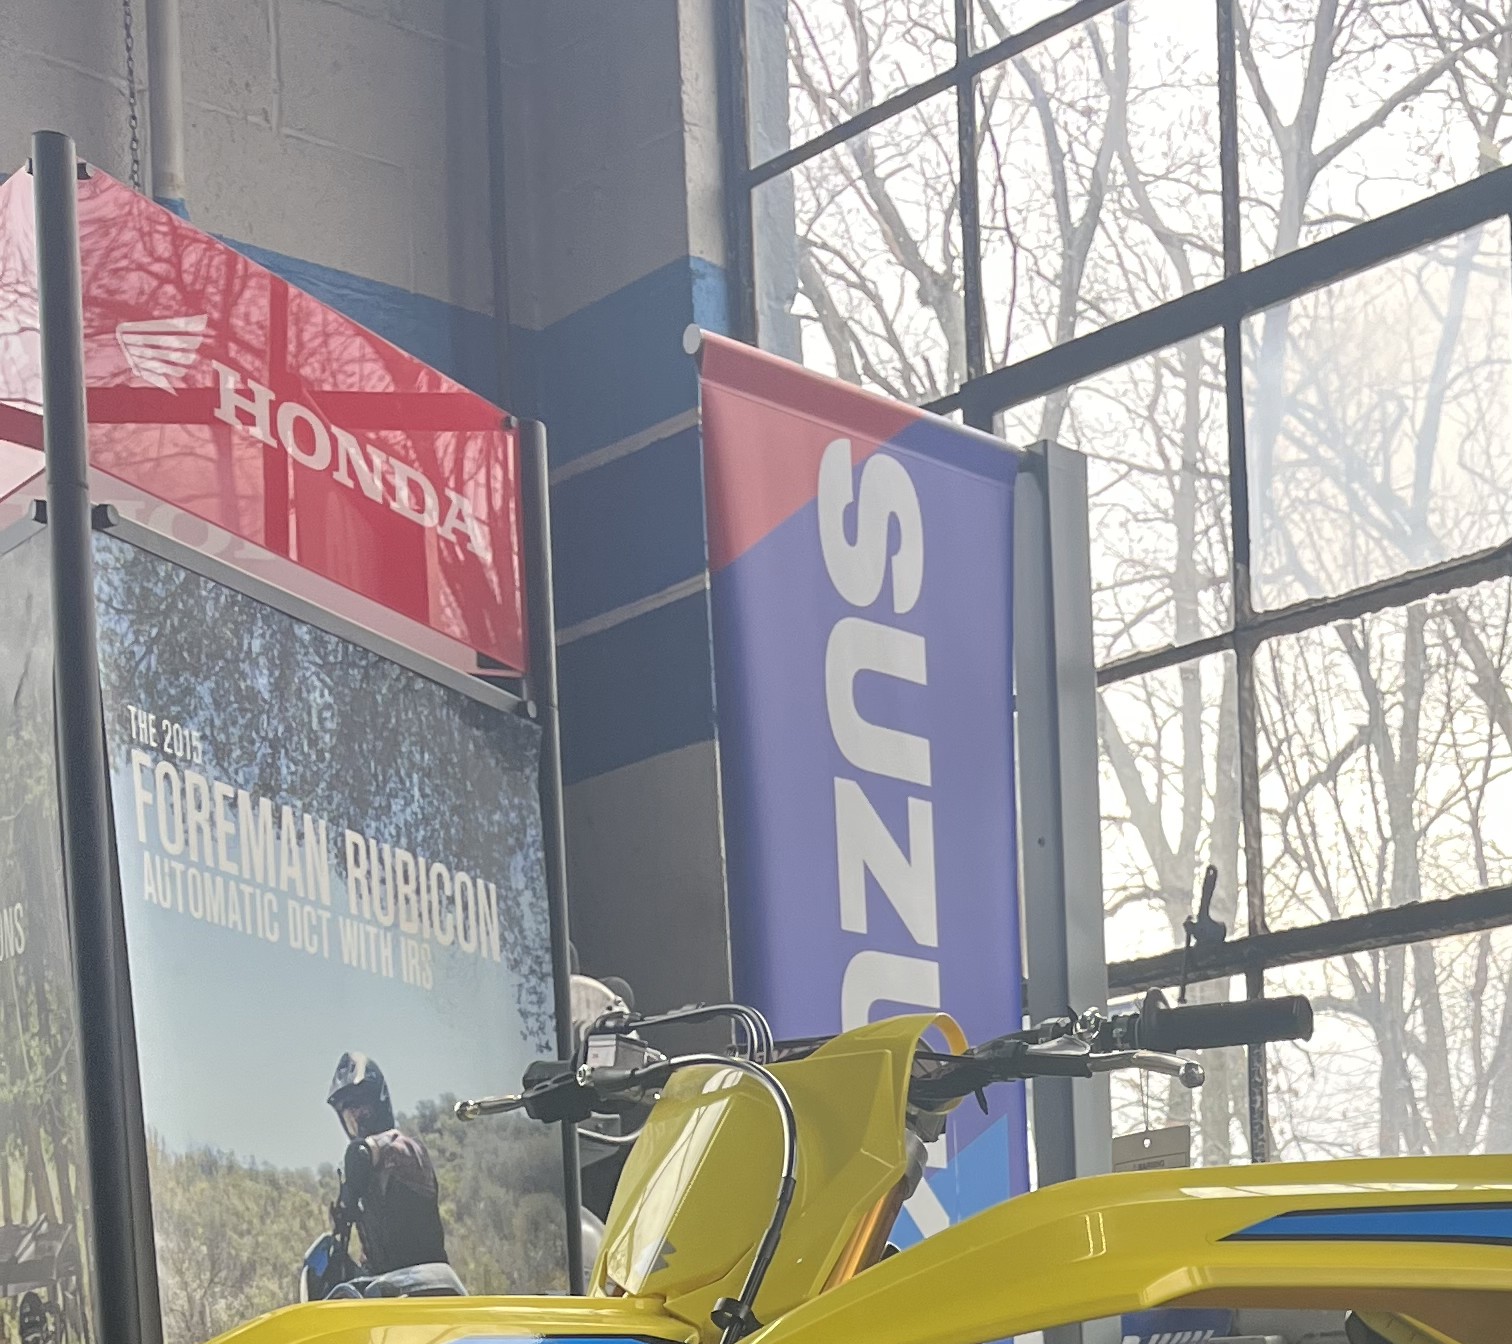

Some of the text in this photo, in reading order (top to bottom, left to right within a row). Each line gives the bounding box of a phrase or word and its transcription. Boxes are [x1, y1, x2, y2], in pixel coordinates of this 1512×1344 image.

[211, 359, 491, 559] HONDA
[127, 704, 203, 764] THE 2015
[131, 748, 501, 963] FOREMAN RUBICON
[143, 850, 434, 991] AUTOMATIC DCT WITH IRS
